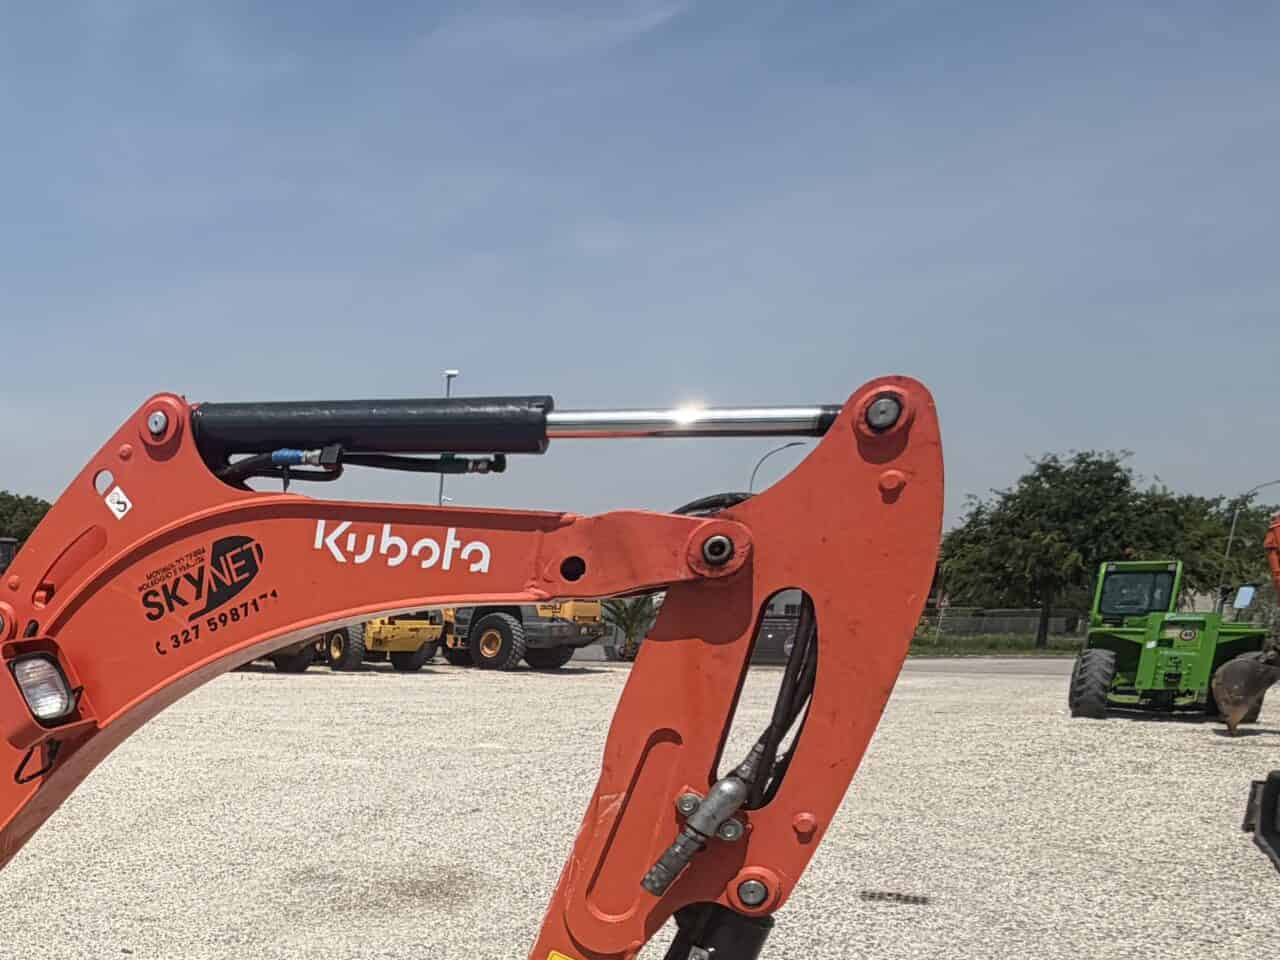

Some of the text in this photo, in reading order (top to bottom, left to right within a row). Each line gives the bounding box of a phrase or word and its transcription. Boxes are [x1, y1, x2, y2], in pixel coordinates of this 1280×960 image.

[313, 519, 491, 573] Kubota
[142, 541, 264, 621] SKYNET
[170, 624, 200, 649] 327
